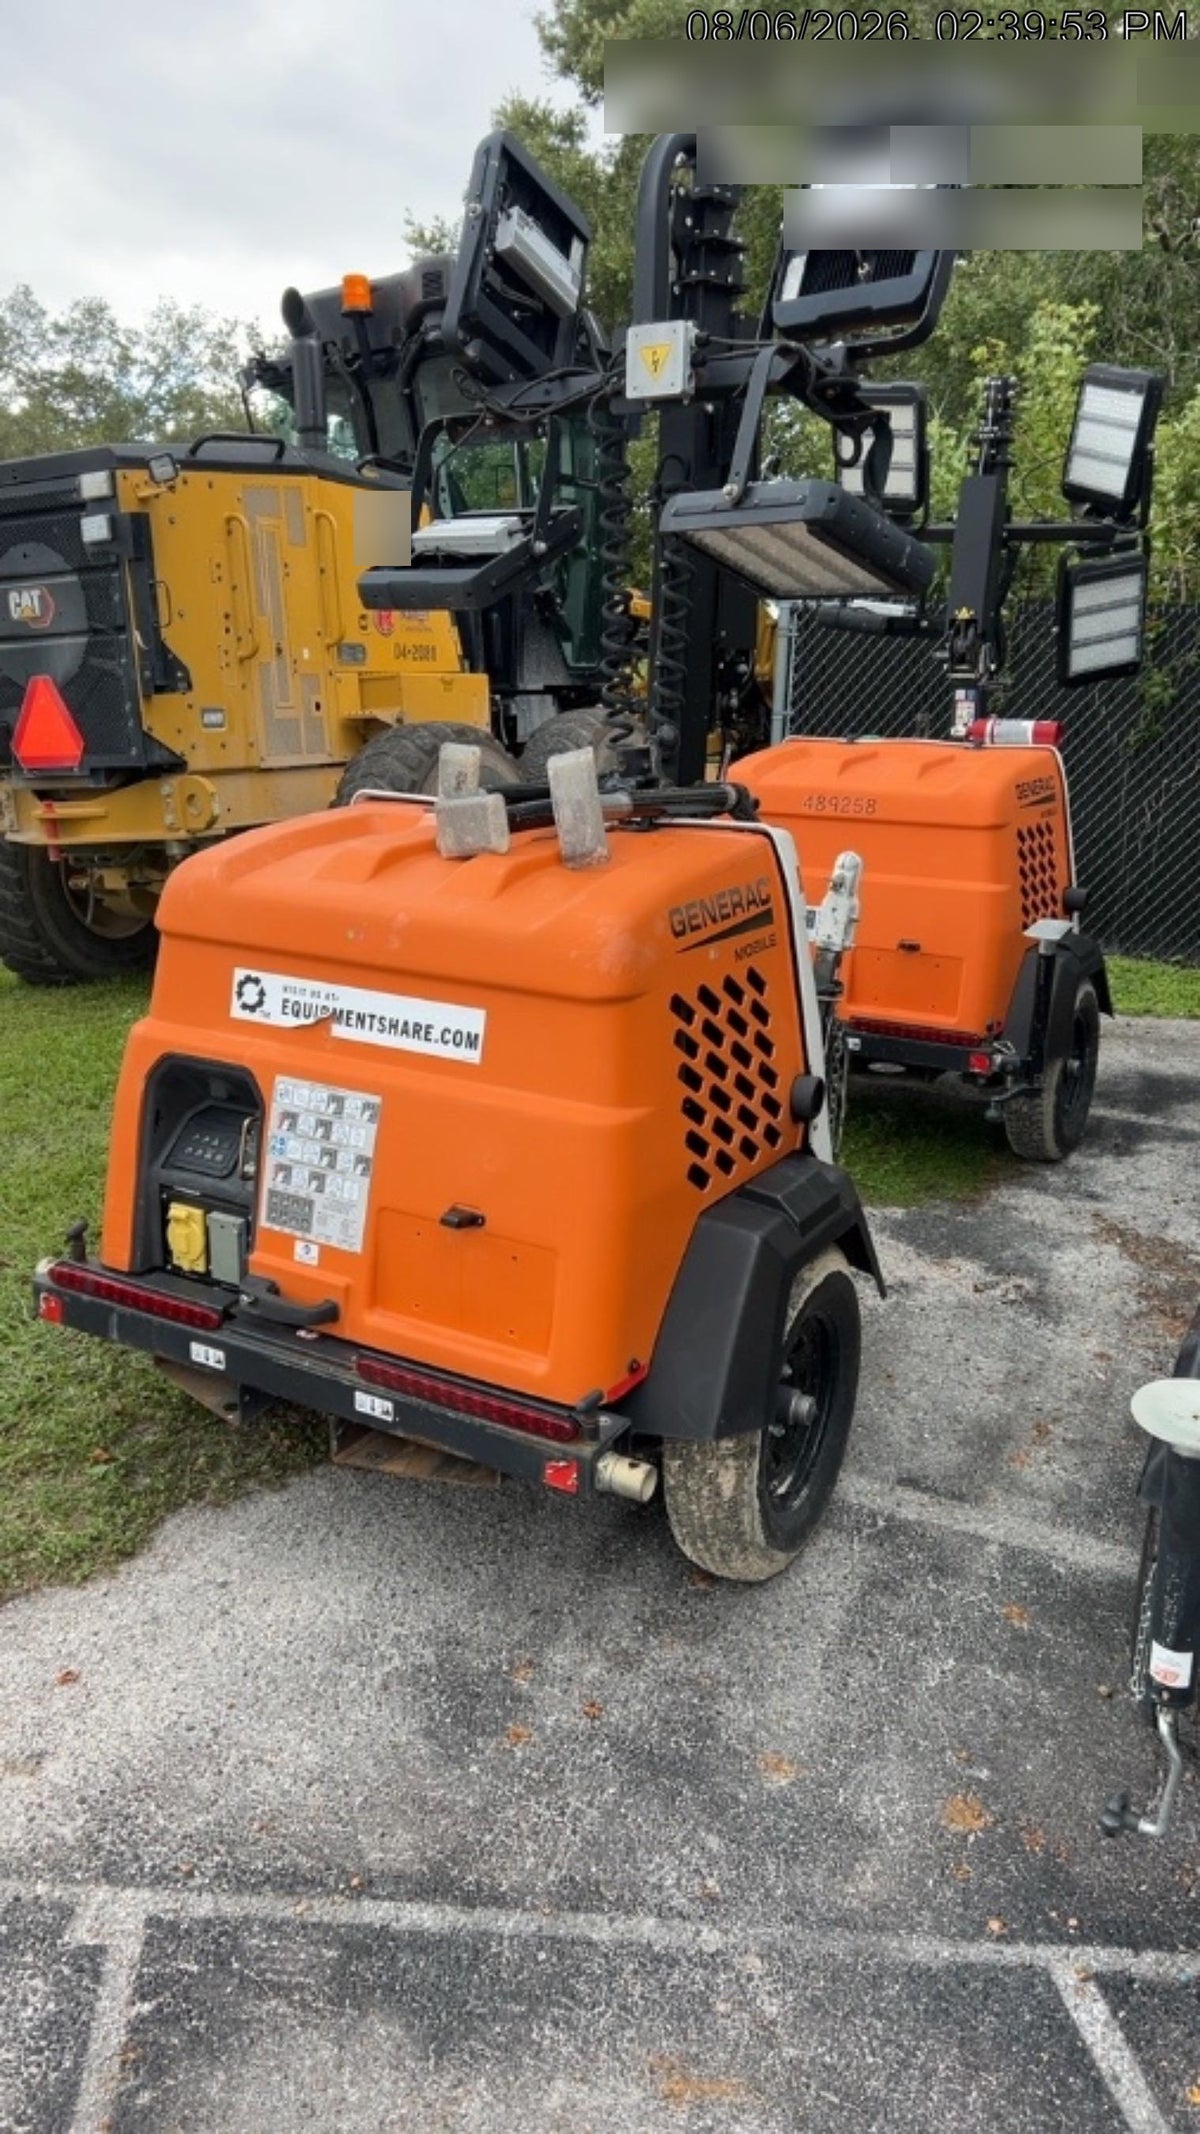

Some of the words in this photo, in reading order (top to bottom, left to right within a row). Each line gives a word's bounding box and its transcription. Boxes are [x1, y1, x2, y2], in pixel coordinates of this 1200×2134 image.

[9, 590, 41, 620] CAT
[803, 794, 876, 814] 489258
[668, 876, 772, 938] GENERAC
[734, 933, 777, 961] MOBILE
[281, 998, 480, 1051] EQUIPMENTSHARE.COM
